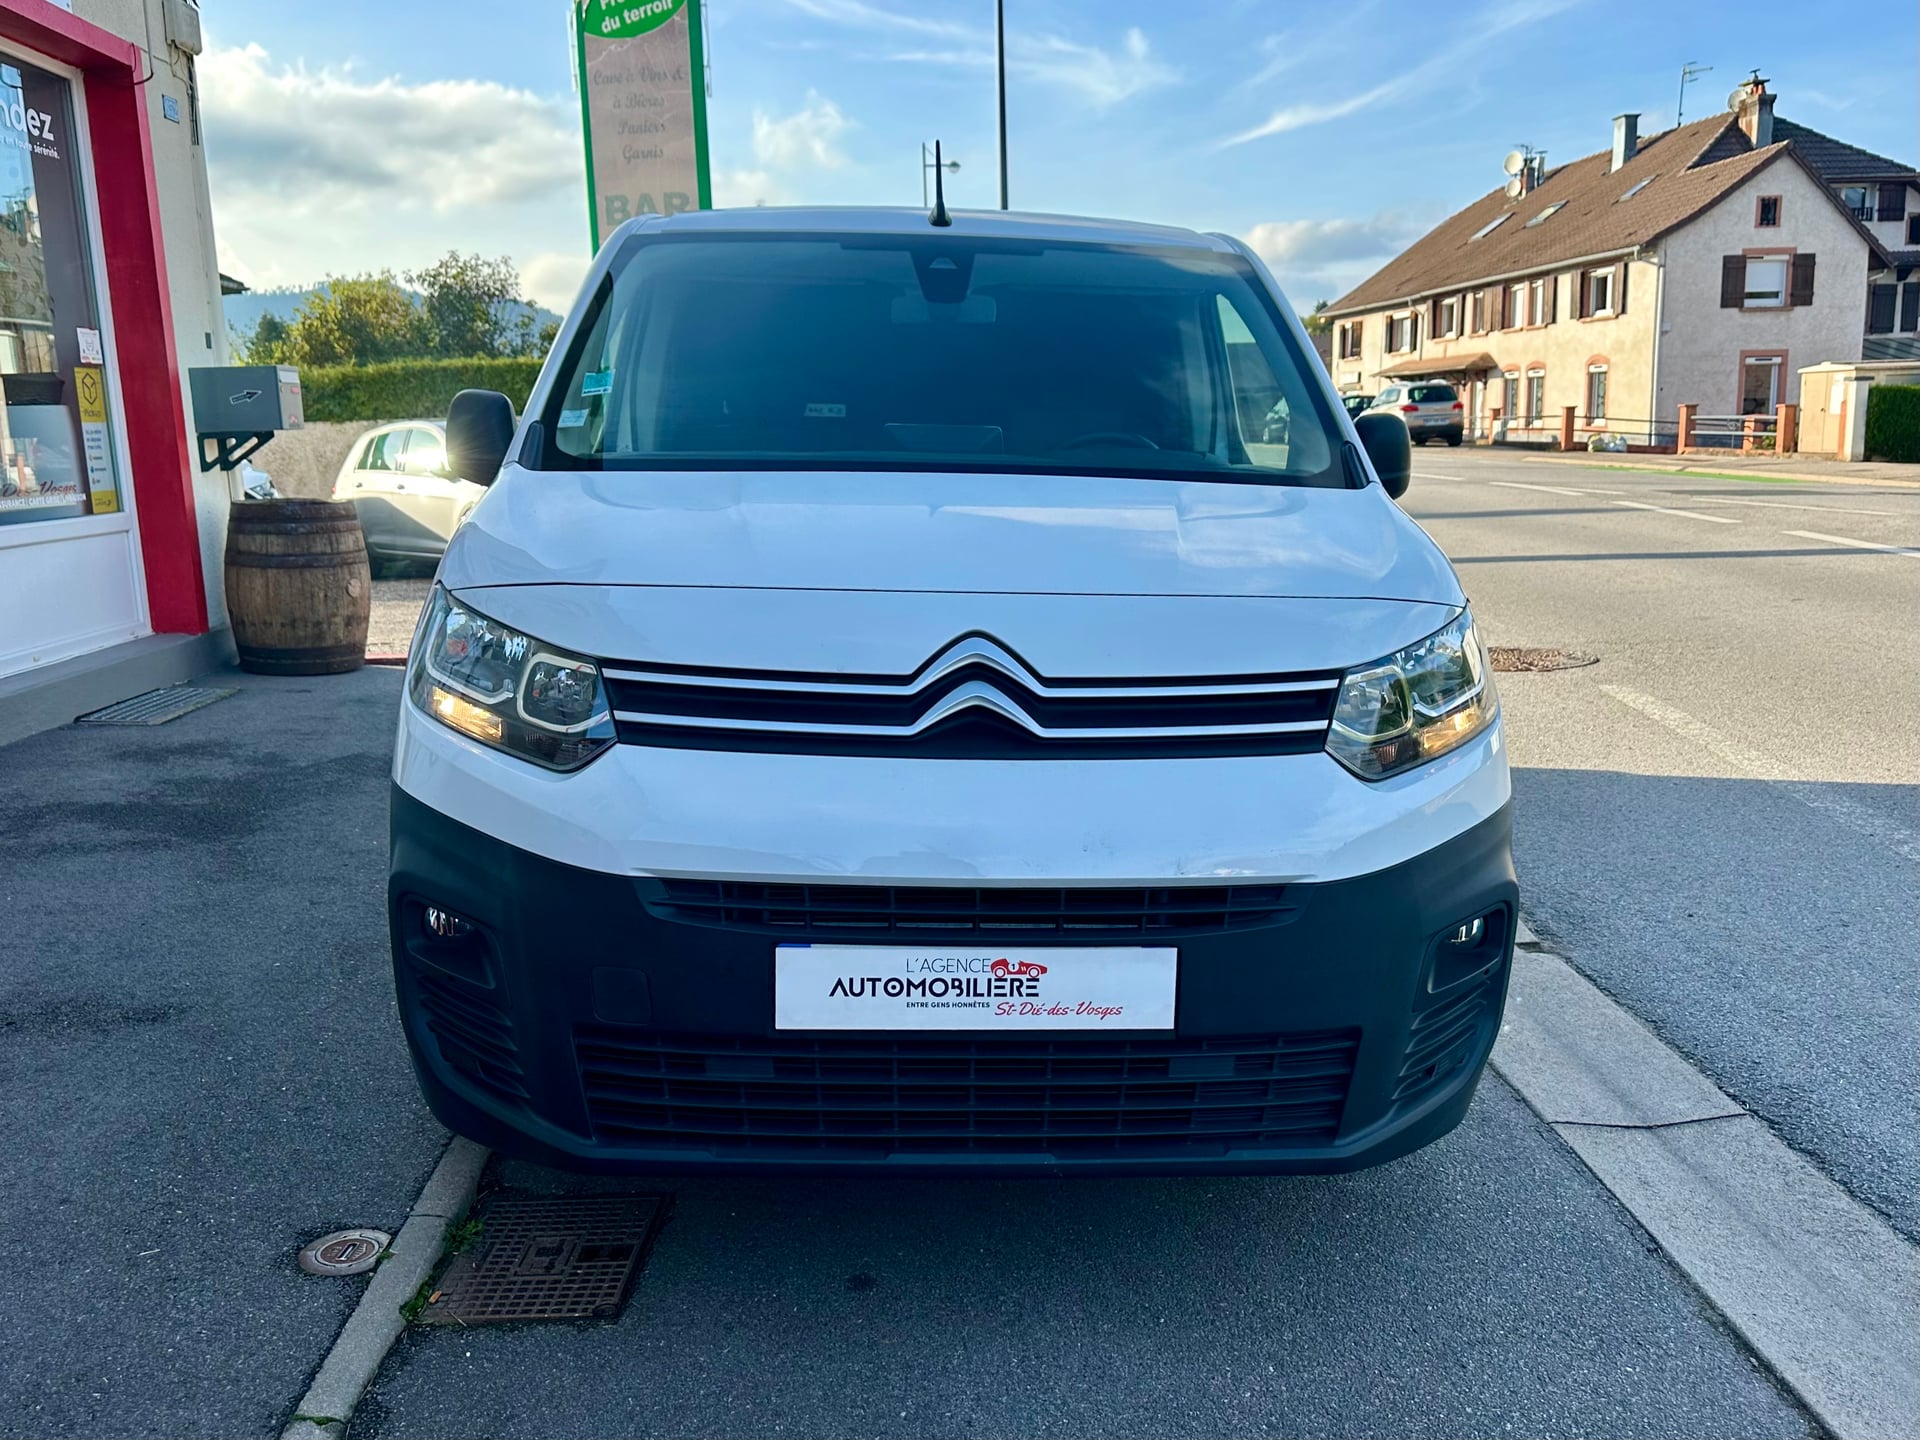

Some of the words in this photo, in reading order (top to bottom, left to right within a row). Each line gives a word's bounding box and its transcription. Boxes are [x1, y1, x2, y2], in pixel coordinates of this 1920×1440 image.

[601, 16, 621, 33] du
[622, 0, 673, 24] terroir
[593, 67, 623, 86] Cave
[639, 65, 668, 82] Vins
[622, 144, 664, 164] Garnis
[906, 958, 991, 973] L'AGENCE
[952, 1000, 990, 1008] HONNÊTES
[994, 1001, 1123, 1020] St-Dié-des-Vosges
